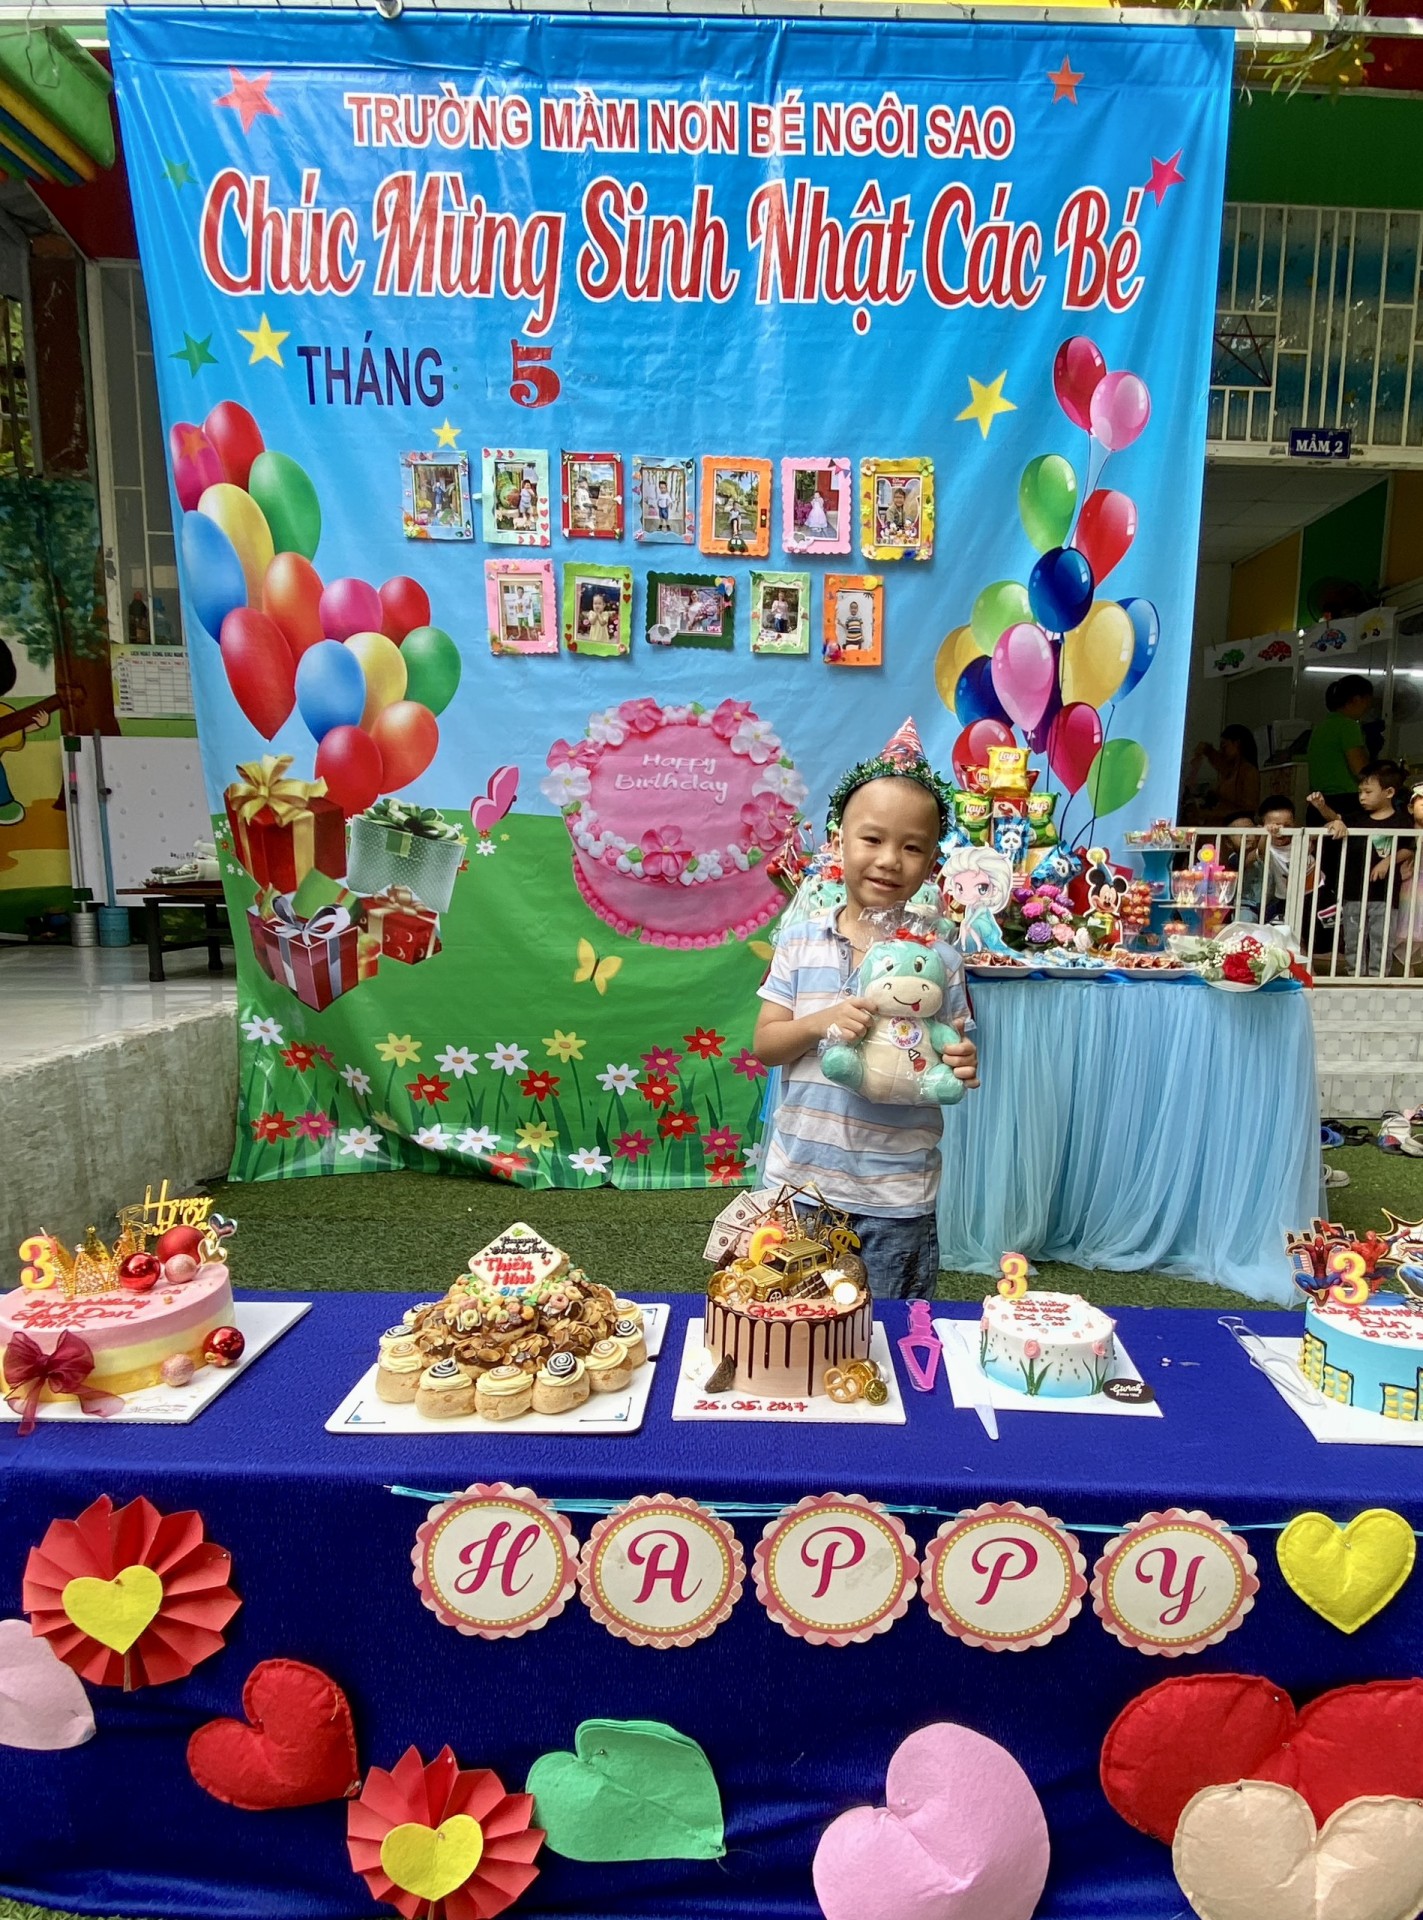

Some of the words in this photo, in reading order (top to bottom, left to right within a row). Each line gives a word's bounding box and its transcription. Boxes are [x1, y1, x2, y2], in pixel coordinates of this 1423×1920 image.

[345, 83, 528, 149] TRƯỜNG
[541, 85, 638, 152] MẦM
[648, 100, 738, 153] NON
[748, 90, 804, 158] BÉ
[813, 92, 916, 157] NGÔI
[925, 104, 1015, 159] SAO
[202, 167, 365, 296] Chúc
[372, 171, 566, 335] Mừng
[577, 178, 740, 303] Sinh
[748, 179, 914, 335] Nhật
[923, 182, 1046, 309] Các
[1055, 186, 1145, 312] Bé
[509, 339, 561, 409] 5
[1334, 440, 1343, 453] 2
[614, 772, 729, 805] Birthday
[642, 753, 717, 775] Happy
[144, 1179, 213, 1224] Happy
[19, 1236, 57, 1290] 3
[997, 1253, 1029, 1299] 3
[1330, 1249, 1369, 1306] 3
